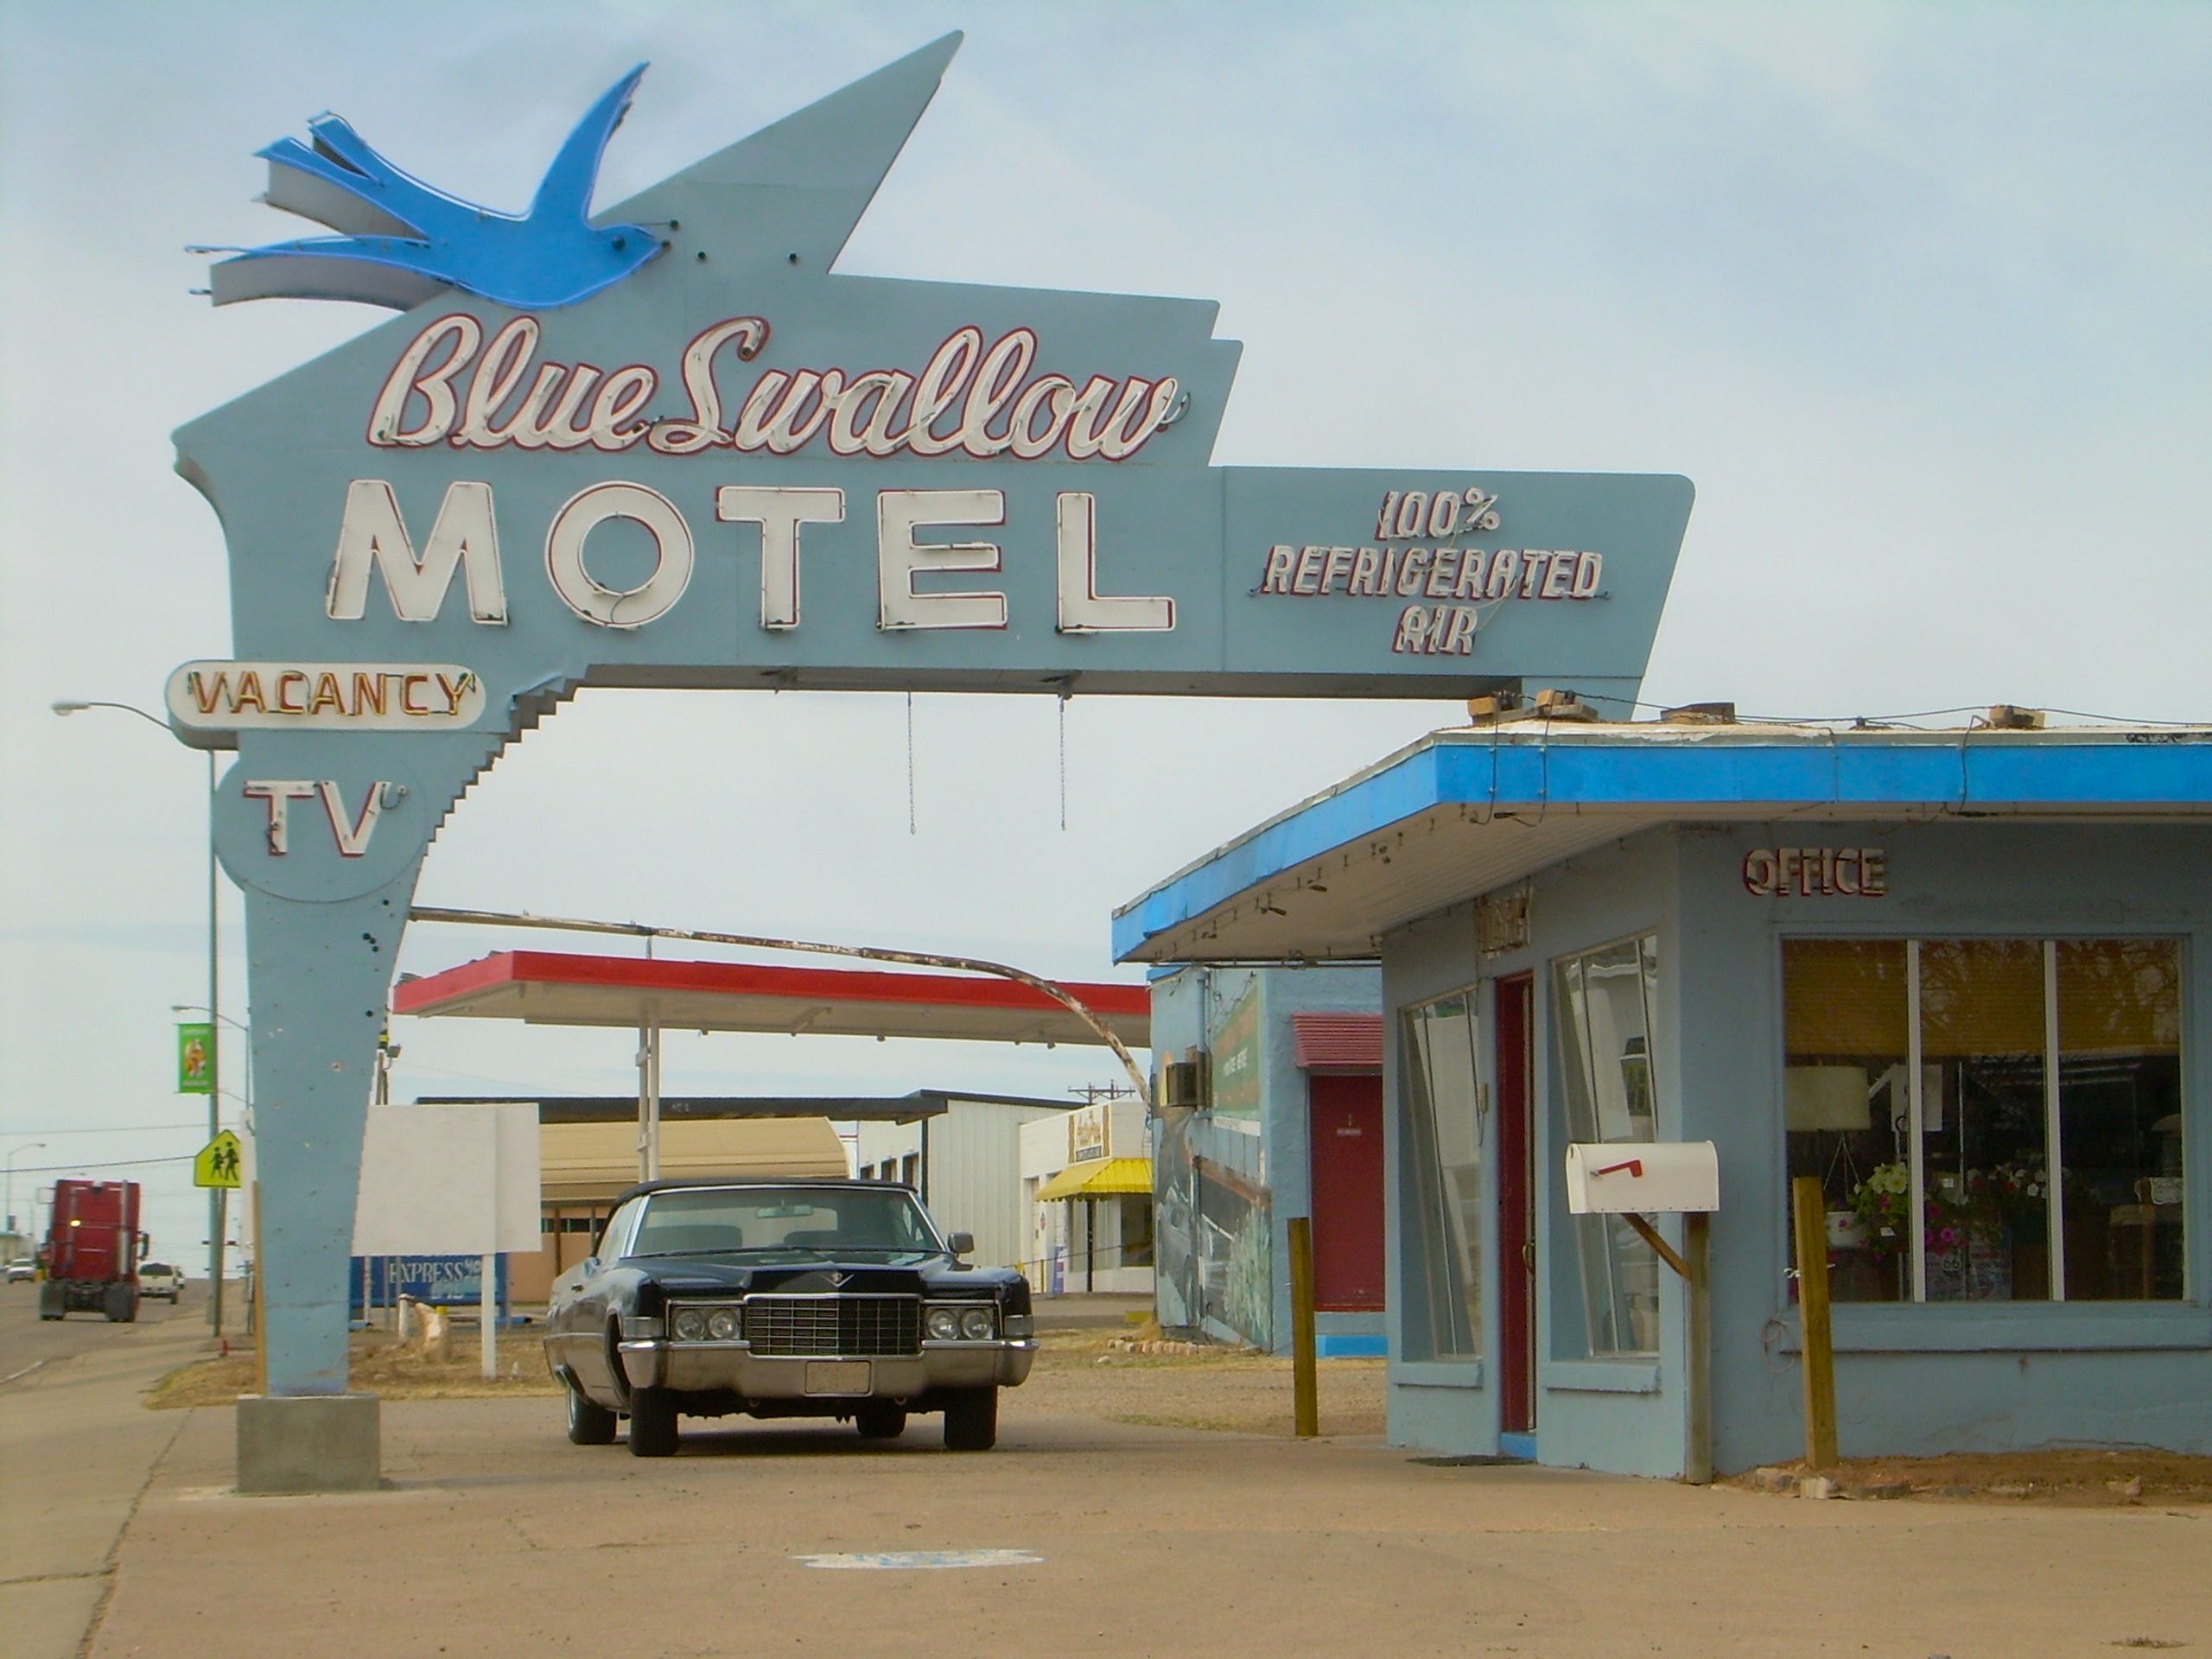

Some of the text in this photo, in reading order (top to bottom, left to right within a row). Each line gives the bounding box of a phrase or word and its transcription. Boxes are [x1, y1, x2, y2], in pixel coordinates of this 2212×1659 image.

[366, 313, 1179, 459] Blue Swallow
[1375, 487, 1501, 541] 100%
[326, 478, 1175, 633] MOTEL
[1261, 545, 1604, 600] REFRIGERATED
[1392, 605, 1478, 655] AIR
[188, 670, 474, 716] VACANCY
[243, 780, 391, 856] TV
[1743, 847, 1887, 896] OFFICE
[390, 1262, 464, 1284] EXPRESS
